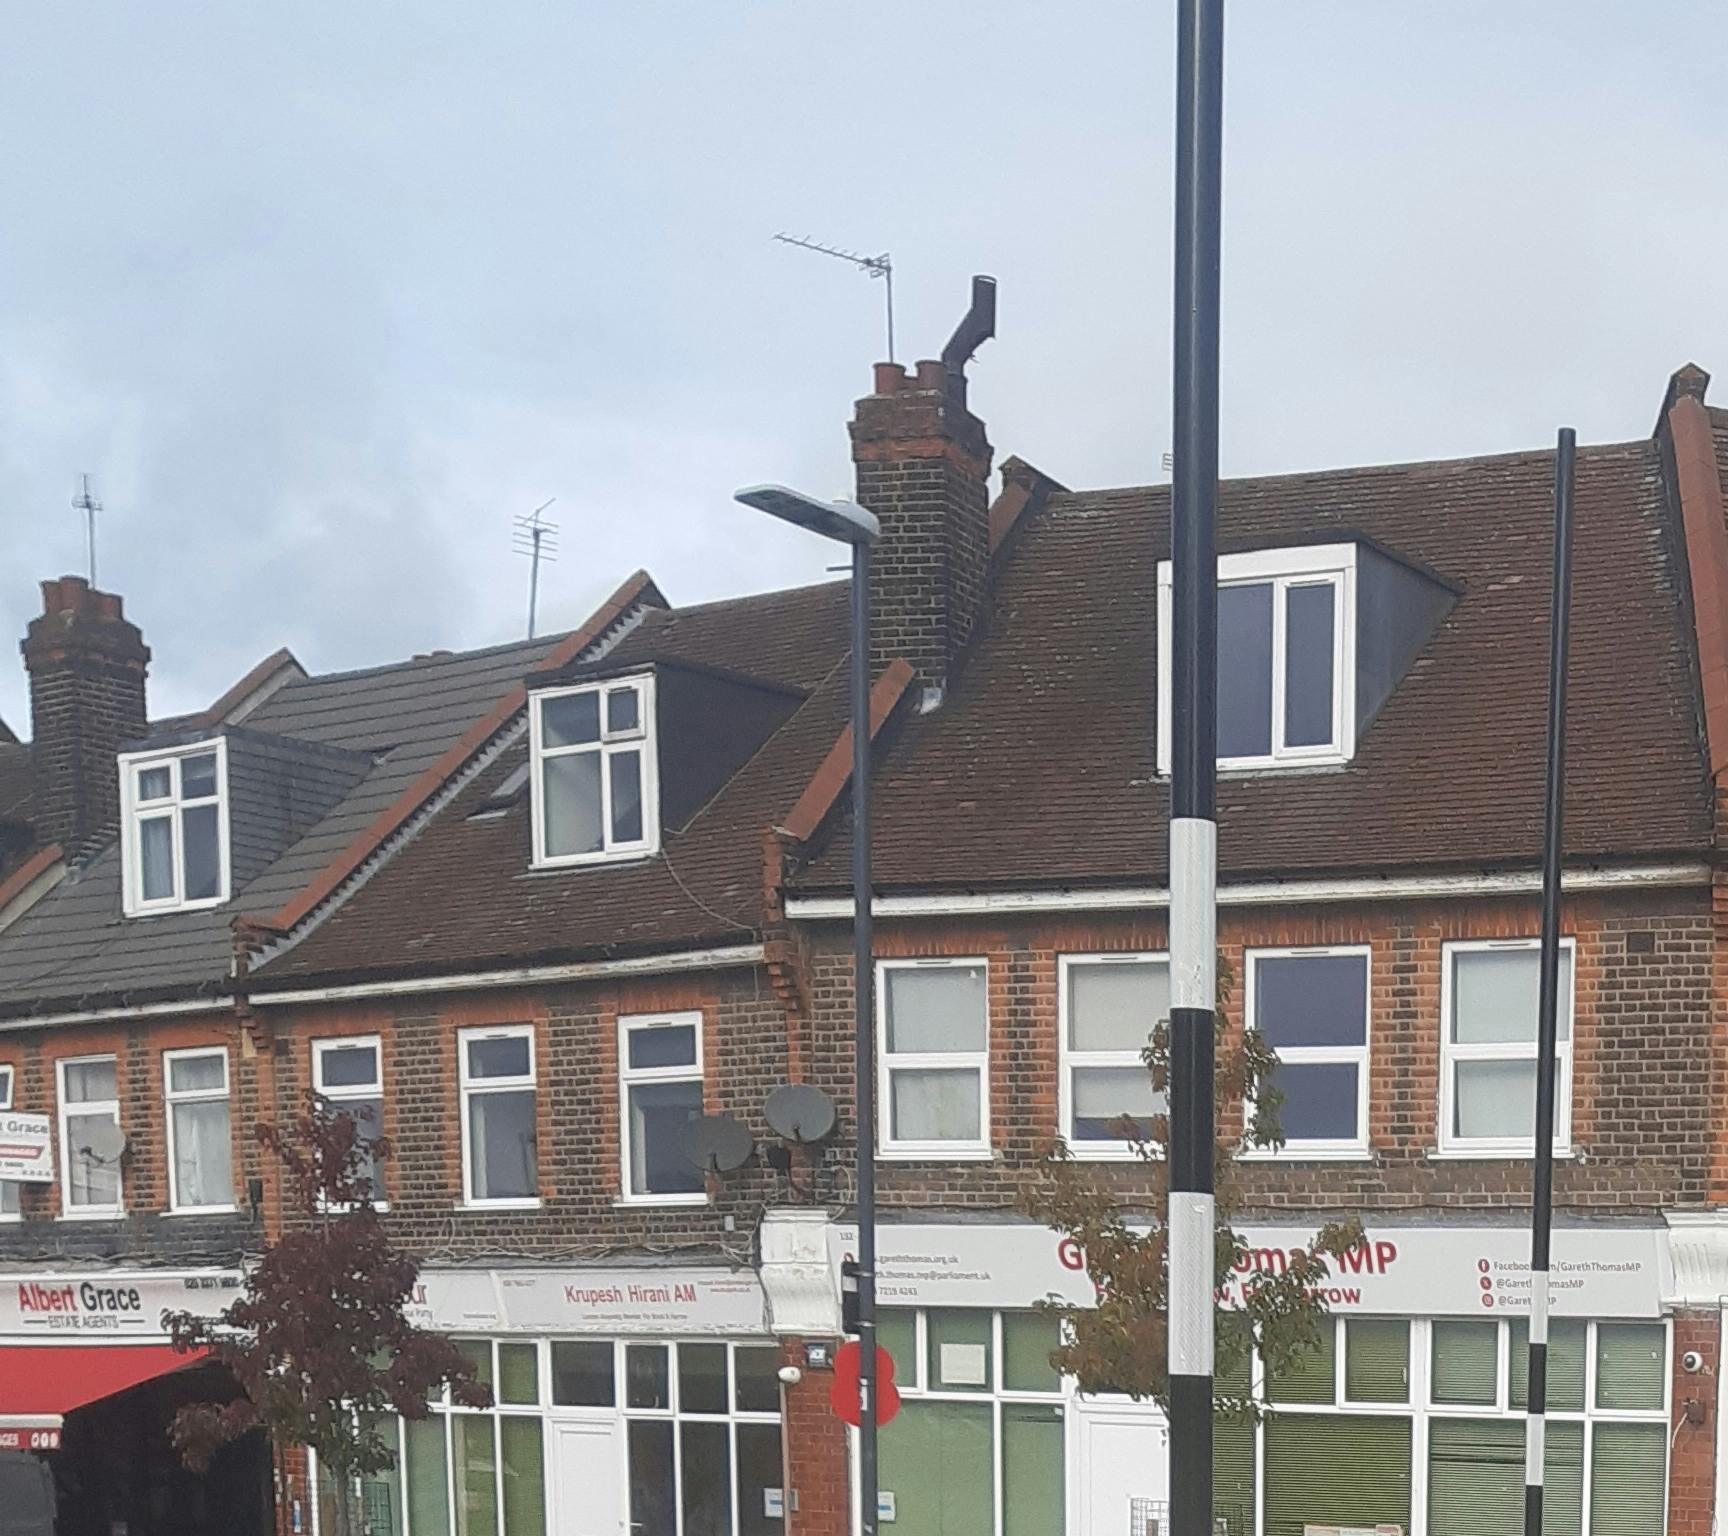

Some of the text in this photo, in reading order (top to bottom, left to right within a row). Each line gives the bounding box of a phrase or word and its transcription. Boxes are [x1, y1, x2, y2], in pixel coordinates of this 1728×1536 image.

[7, 1120, 49, 1134] Grace
[1337, 1241, 1398, 1275] MP
[18, 1282, 141, 1312] Albert Grace
[564, 1284, 697, 1307] Krupesh Hirani AM
